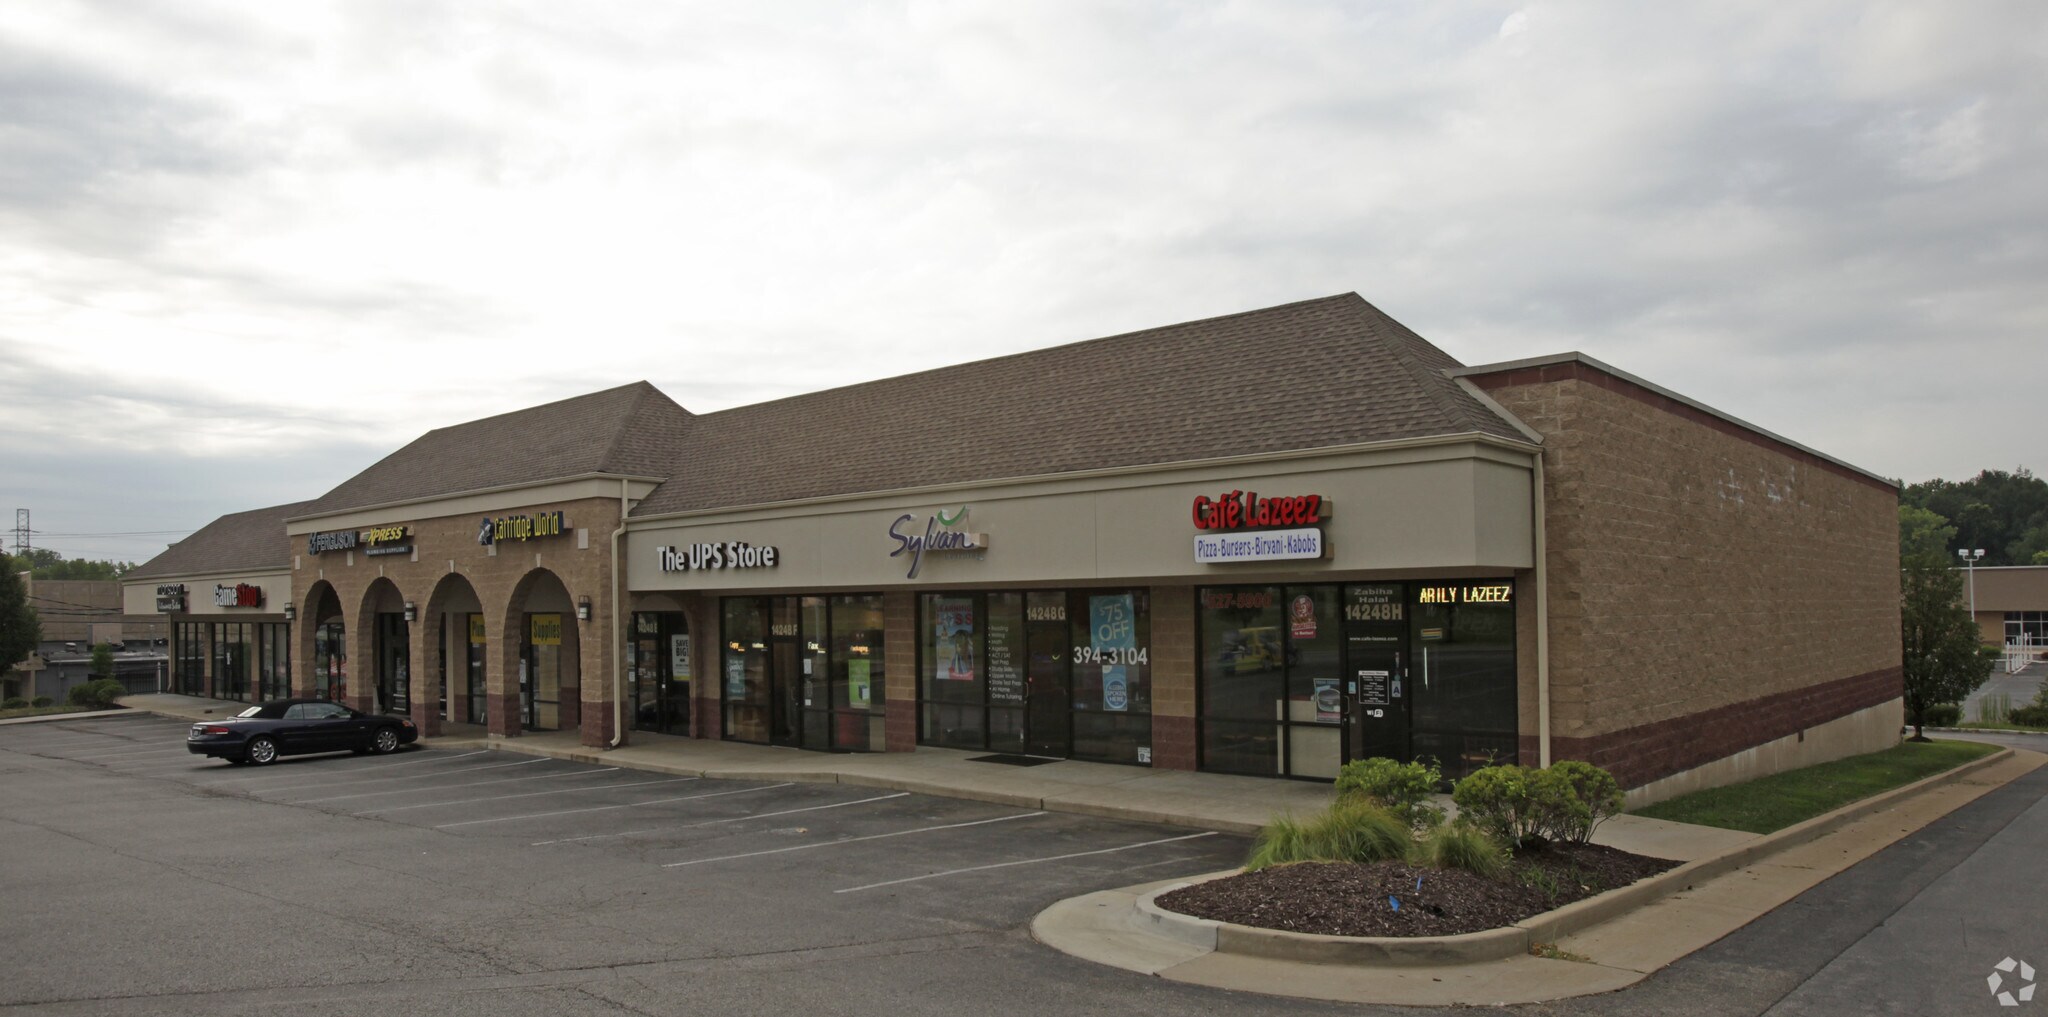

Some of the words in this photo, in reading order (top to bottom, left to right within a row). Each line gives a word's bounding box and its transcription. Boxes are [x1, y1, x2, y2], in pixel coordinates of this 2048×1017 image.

[1192, 489, 1240, 530] Café
[1245, 491, 1319, 527] Lazeez
[367, 527, 404, 546] XPRESS
[494, 516, 532, 542] Cartridge
[533, 512, 559, 537] World
[316, 530, 356, 551] FERGUSON
[889, 514, 975, 579] Sylvan
[656, 546, 685, 571] The
[689, 543, 722, 570] UPS
[727, 541, 774, 569] Store
[213, 583, 258, 608] GameStop
[1354, 588, 1393, 596] Zabiha
[1359, 596, 1389, 604] Halal
[1420, 587, 1457, 603] ARILY
[1462, 586, 1510, 602] LAZEEZ
[1099, 603, 1123, 622] $75
[533, 619, 561, 641] Supplies
[1098, 620, 1130, 642] OFF
[675, 639, 689, 647] SAVE
[807, 641, 819, 650] Fax
[1073, 646, 1149, 666] 394-3104
[1393, 686, 1400, 694] A
